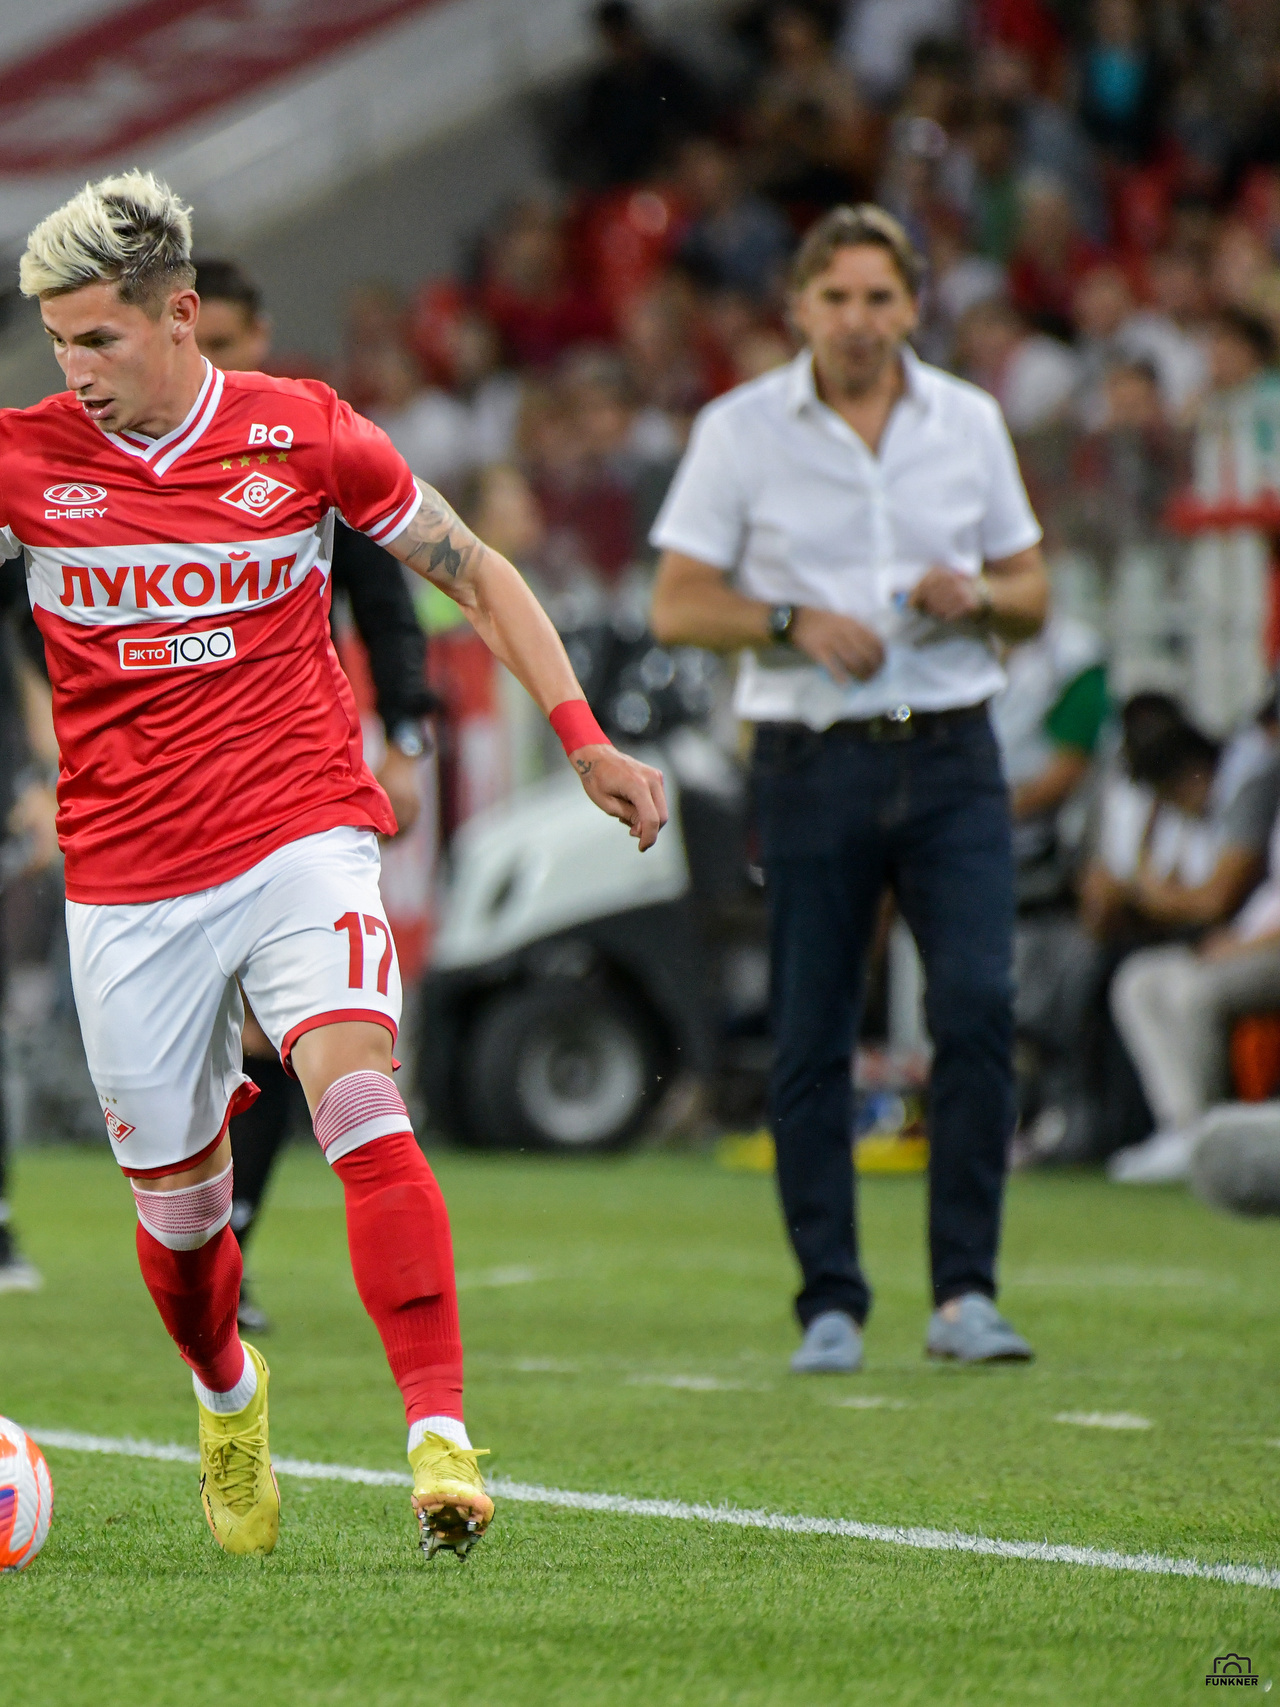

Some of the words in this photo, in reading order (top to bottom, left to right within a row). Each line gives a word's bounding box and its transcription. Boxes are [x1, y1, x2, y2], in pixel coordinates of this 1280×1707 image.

[247, 423, 294, 449] BQ
[44, 507, 108, 520] CHERY
[59, 550, 298, 609] ЛУКОЙЛ
[333, 911, 394, 997] 17
